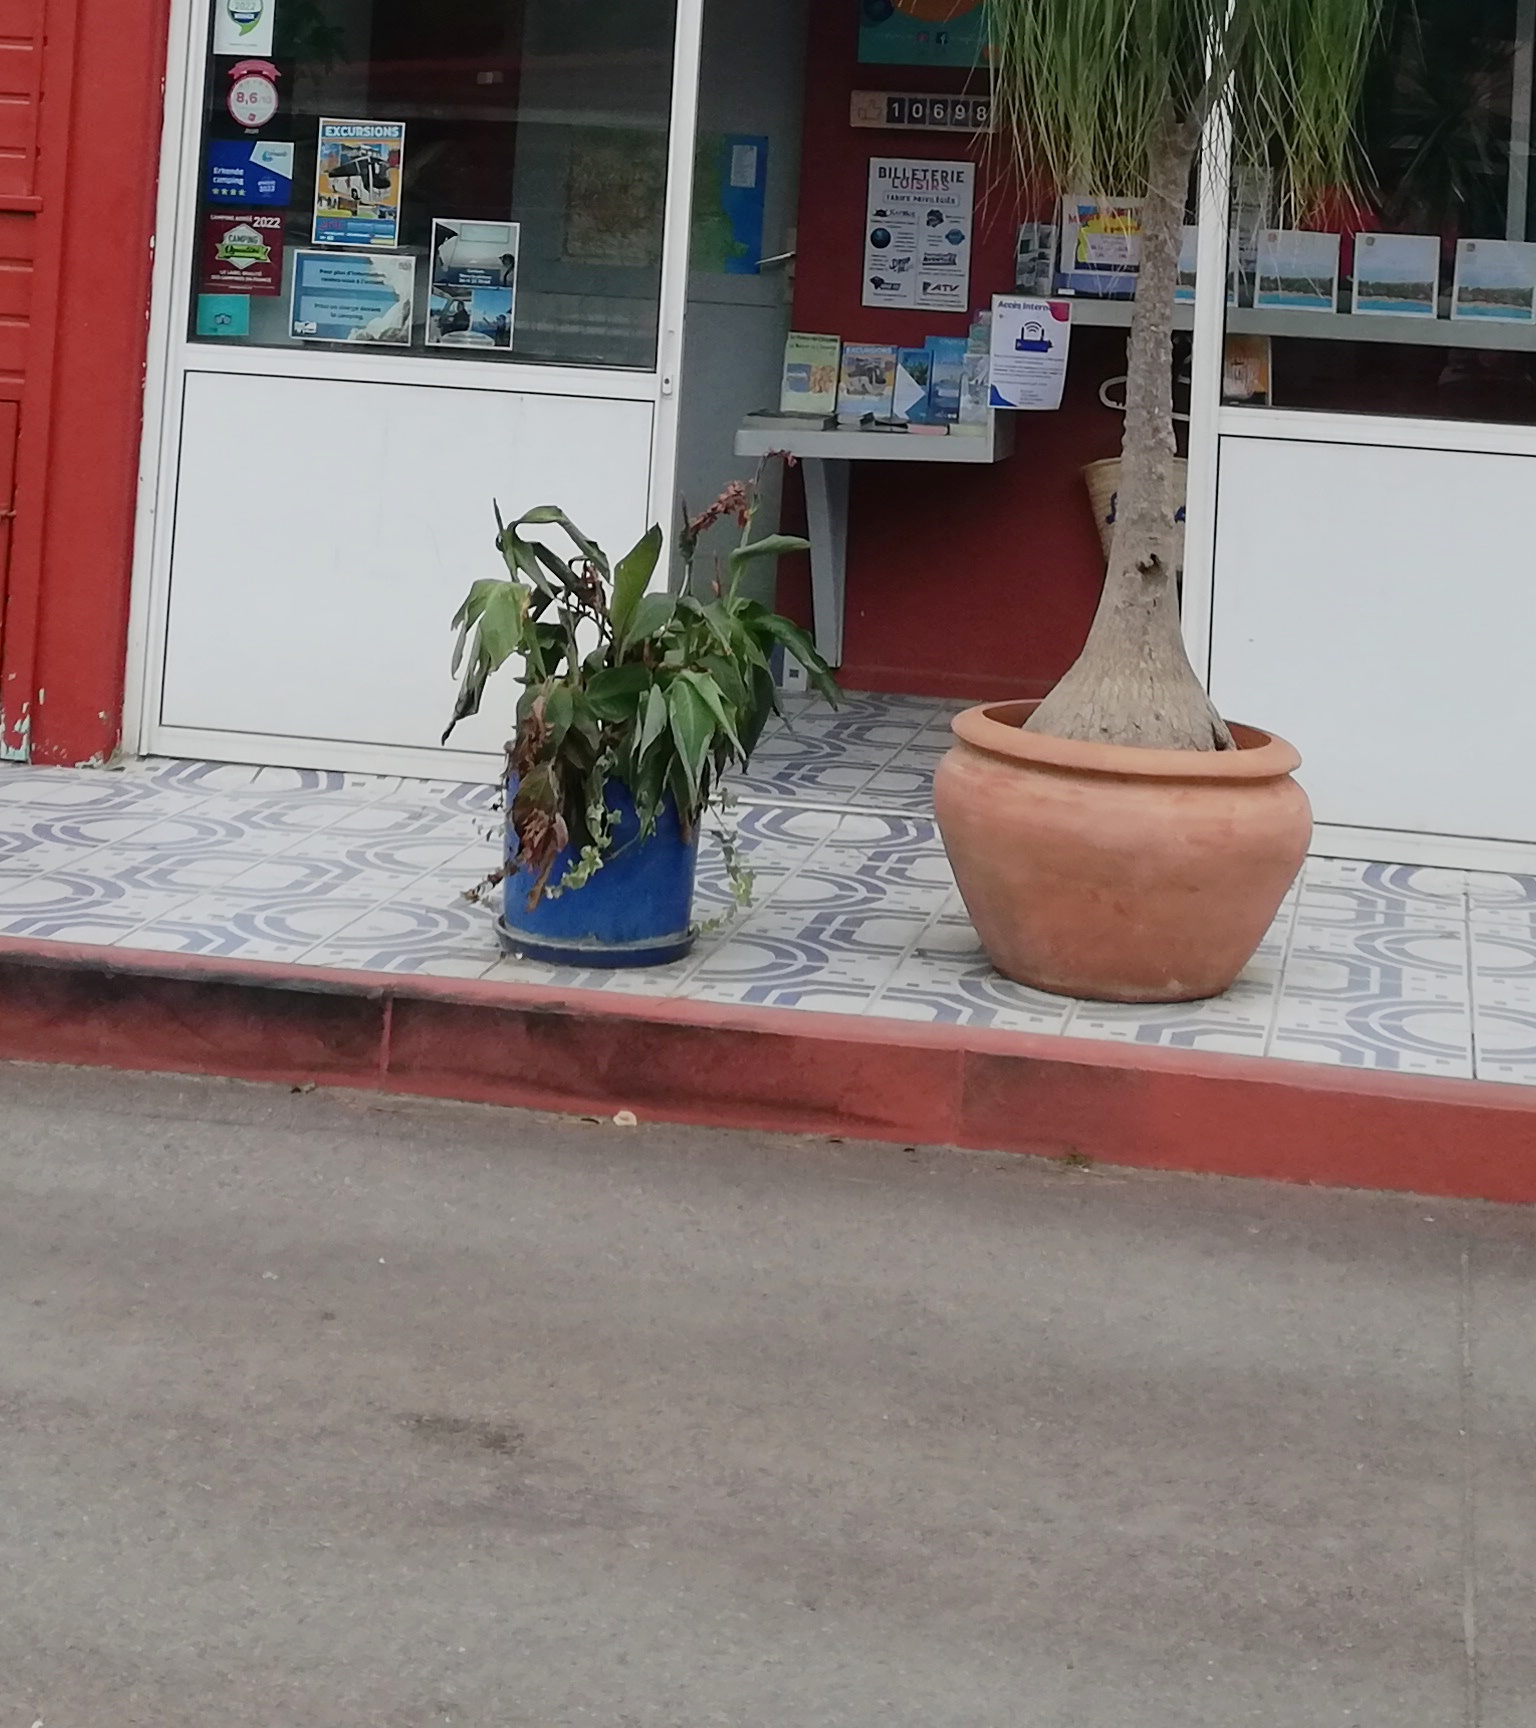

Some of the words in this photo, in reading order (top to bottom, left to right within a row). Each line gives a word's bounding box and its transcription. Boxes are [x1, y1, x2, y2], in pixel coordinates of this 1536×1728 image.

[891, 102, 988, 121] 10698
[325, 126, 400, 137] EXCURSIONS
[878, 166, 965, 183] BILLETERIE
[892, 176, 951, 191] LOISIRS
[252, 216, 281, 229] 2022
[228, 234, 258, 244] CAMPING
[931, 283, 960, 292] ATV
